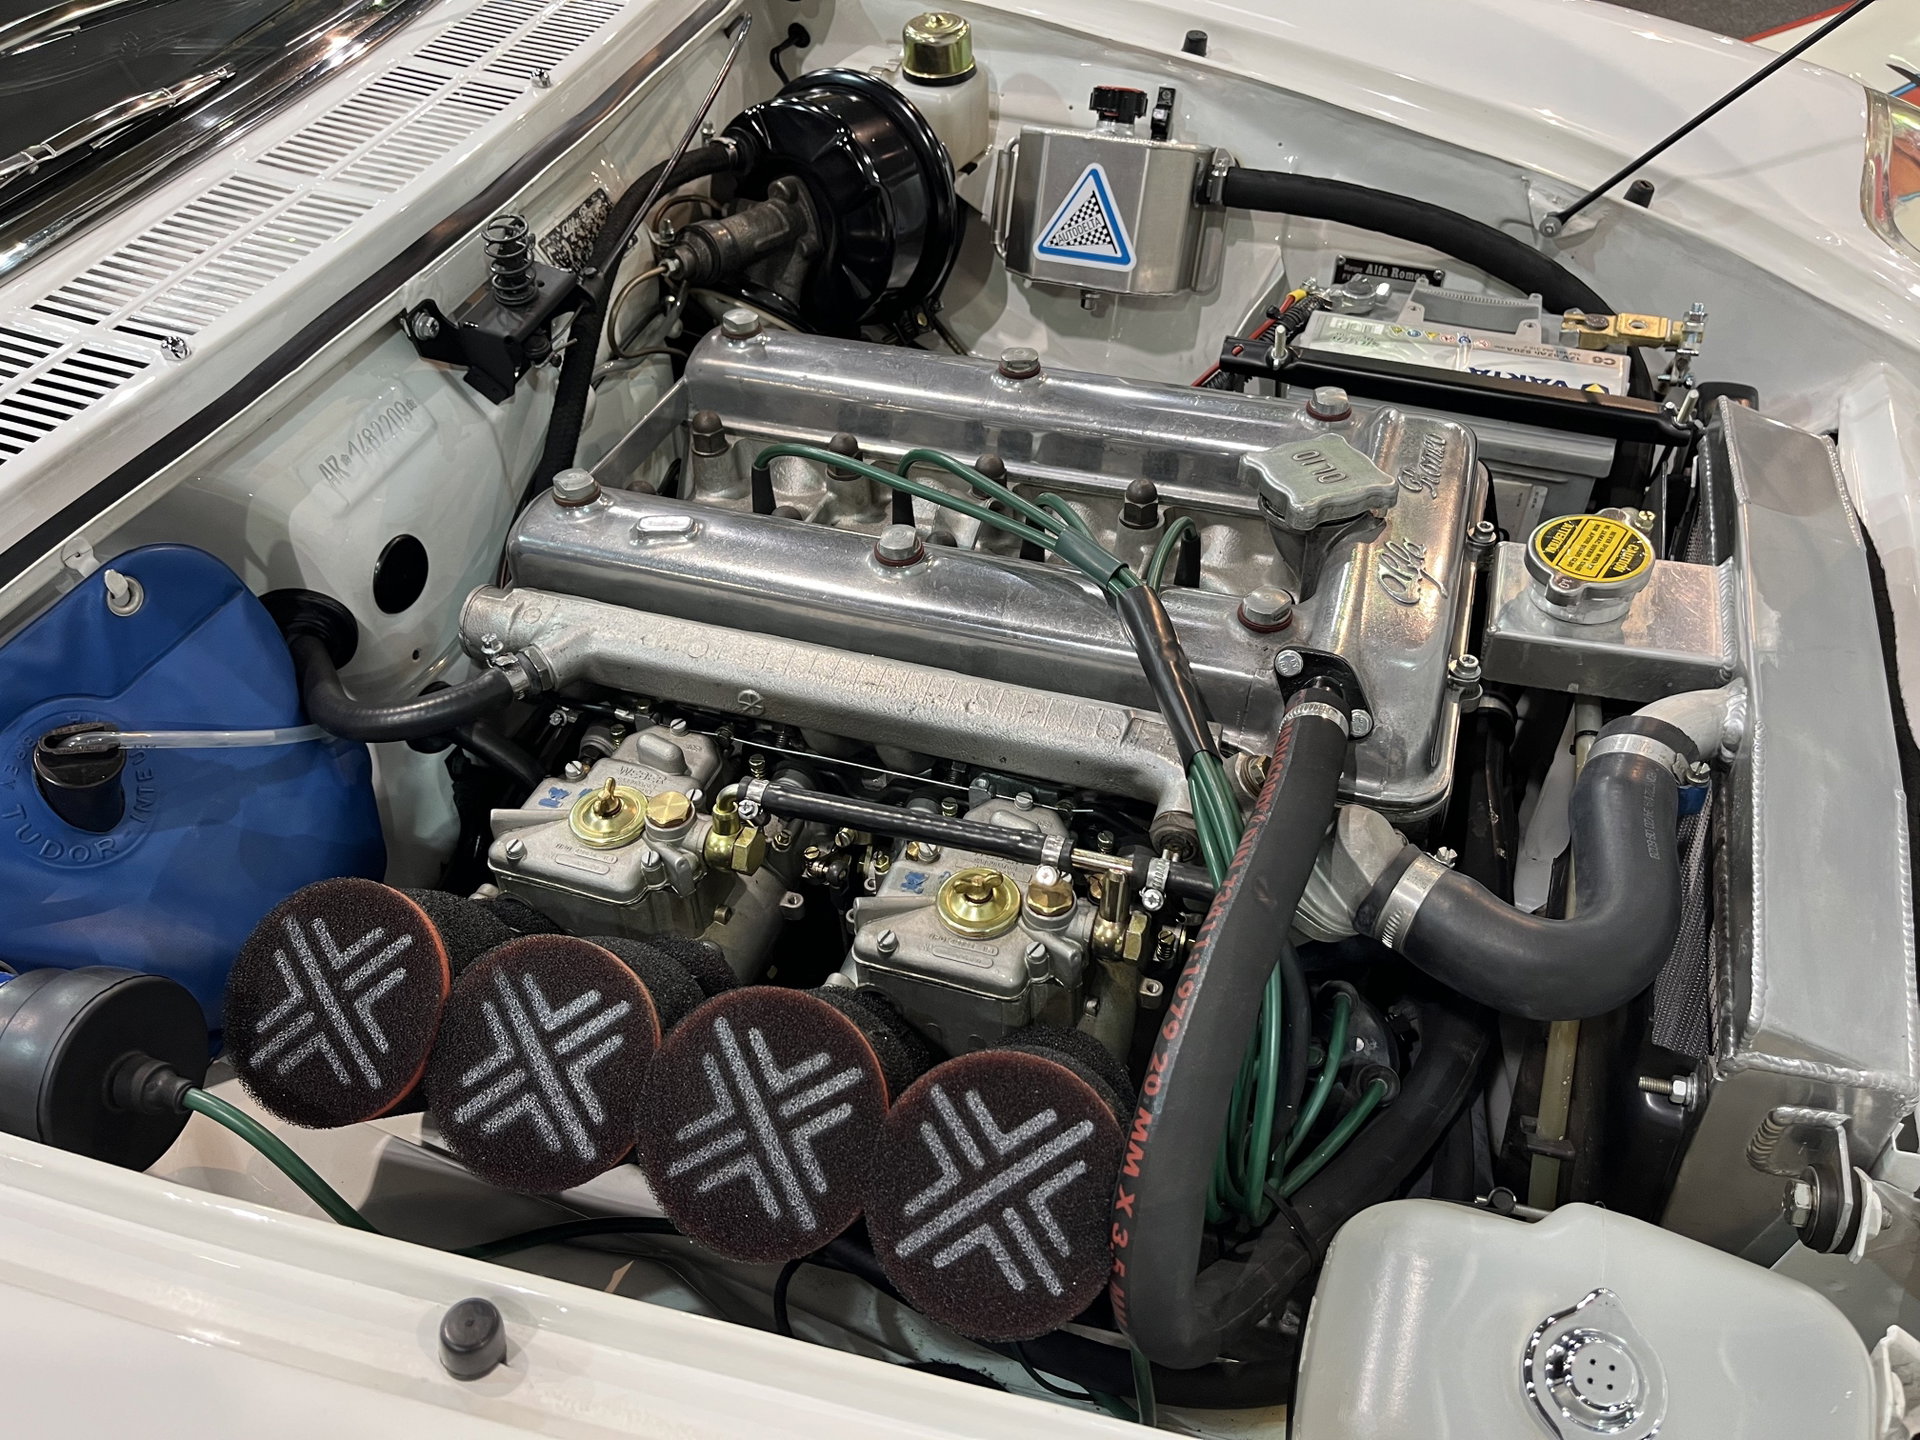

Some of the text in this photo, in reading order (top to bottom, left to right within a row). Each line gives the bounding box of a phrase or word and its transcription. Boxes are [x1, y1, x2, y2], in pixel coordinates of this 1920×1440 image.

[1058, 217, 1102, 242] AUTODELTA
[1365, 263, 1389, 277] Alfa
[1390, 266, 1427, 280] Romeo
[1292, 449, 1349, 484] OLIO
[1397, 432, 1447, 499] Romeo
[1544, 521, 1576, 554] ATTENTION
[1377, 537, 1449, 606] Alfa
[1612, 543, 1640, 573] CAUTION
[2, 804, 120, 863] TUDOR
[1144, 1052, 1168, 1096] 20
[1123, 1107, 1153, 1177] MM
[1115, 1183, 1136, 1218] X
